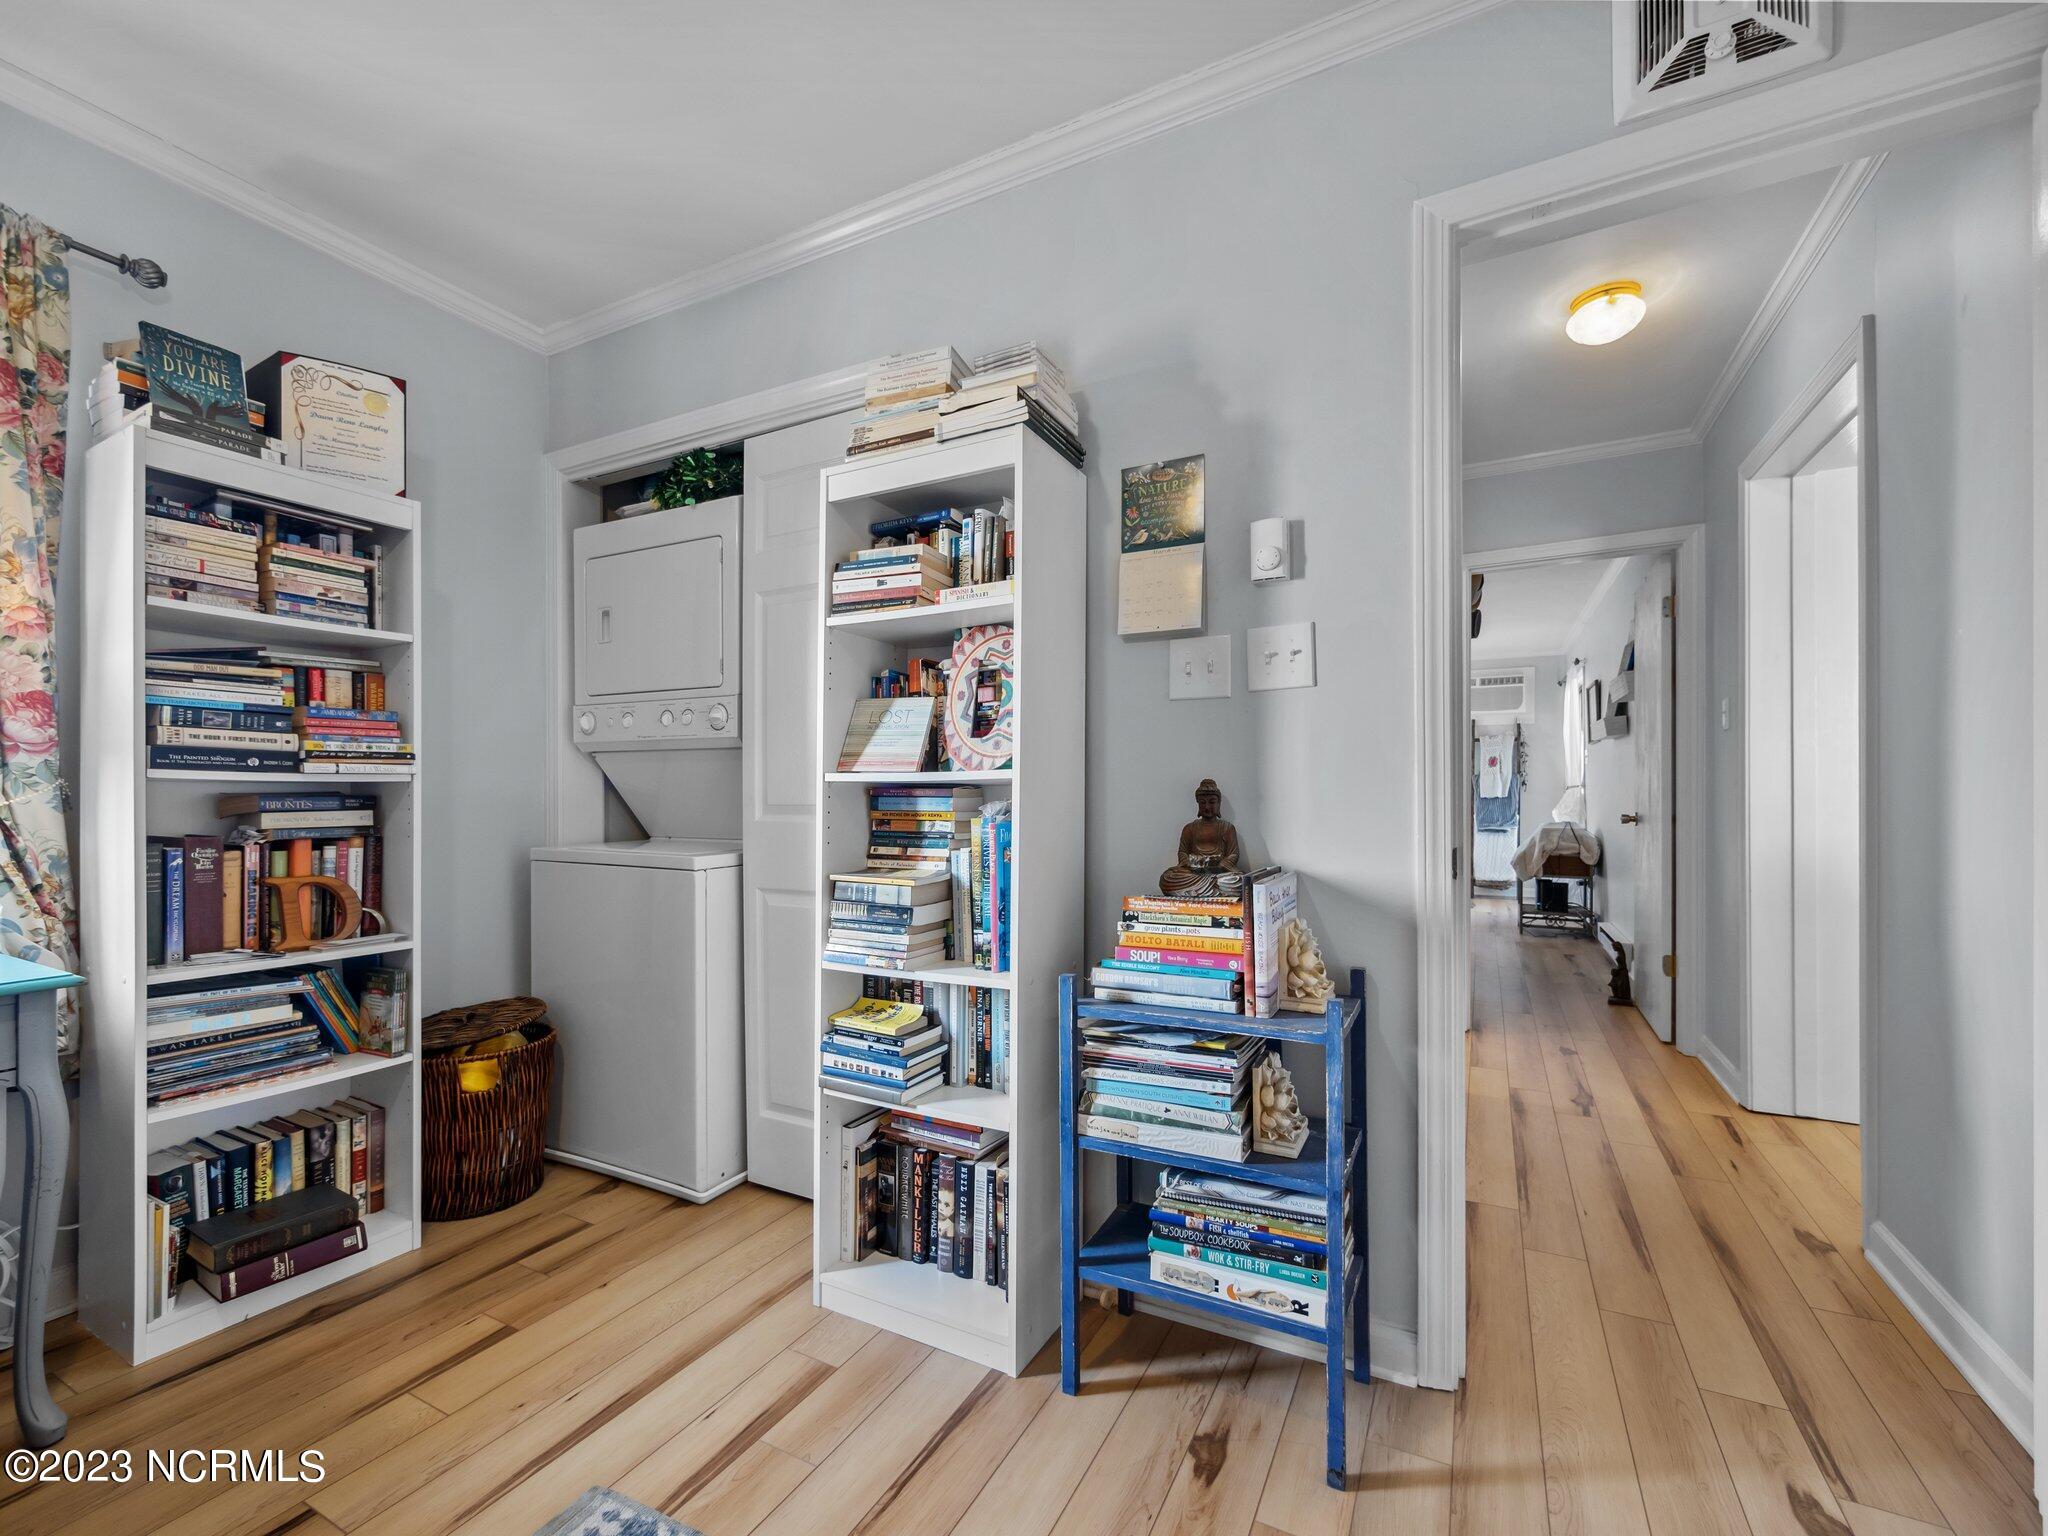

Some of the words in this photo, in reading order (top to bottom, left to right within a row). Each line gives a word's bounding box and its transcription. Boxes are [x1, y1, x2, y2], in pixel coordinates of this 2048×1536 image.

[163, 340, 193, 360] YOU
[201, 354, 229, 373] ARE
[163, 354, 232, 391] DIVINE
[221, 427, 253, 440] PARADE
[218, 440, 251, 452] PARADE
[1138, 478, 1187, 496] NATURE
[956, 592, 989, 600] DICTIONARY
[869, 709, 915, 724] LOST
[982, 837, 991, 867] DRIVES
[172, 881, 181, 909] DREAM
[247, 870, 257, 919] BREAKING
[982, 878, 991, 918] LIFETIME
[1170, 915, 1193, 924] Botanical
[1194, 917, 1208, 926] Magic
[1161, 925, 1181, 934] plants
[1186, 927, 1200, 936] pots
[1126, 935, 1162, 946] MOLTO
[1166, 937, 1205, 949] BATALI
[1130, 950, 1161, 963] SOUP!
[1096, 970, 1125, 984] GORDON
[1125, 973, 1159, 987] RAMSAY'S
[193, 1034, 224, 1046] LAKE
[1131, 1075, 1165, 1084] CHRISTMAS
[1166, 1078, 1197, 1087] COOKBOOK
[1143, 1089, 1161, 1097] SOUTH
[1133, 1099, 1163, 1113] PRATIQUE
[1173, 1110, 1190, 1118] ANNE
[1190, 1112, 1219, 1124] WILLAN
[233, 1167, 243, 1209] MARGARET
[914, 1152, 925, 1252] MANKILLER
[1307, 1203, 1327, 1212] BOOKS
[1206, 1214, 1233, 1225] HEARTY
[1235, 1220, 1258, 1230] SOUPS
[1160, 1225, 1169, 1234] The
[1169, 1226, 1205, 1242] SOUPBOX
[1207, 1235, 1251, 1251] COOKBOOK
[1209, 1223, 1222, 1233] FISH
[1228, 1228, 1250, 1239] shellfish
[1208, 1251, 1224, 1264] WOK
[1227, 1255, 1233, 1265] &
[1235, 1258, 1270, 1274] STIR-FRY
